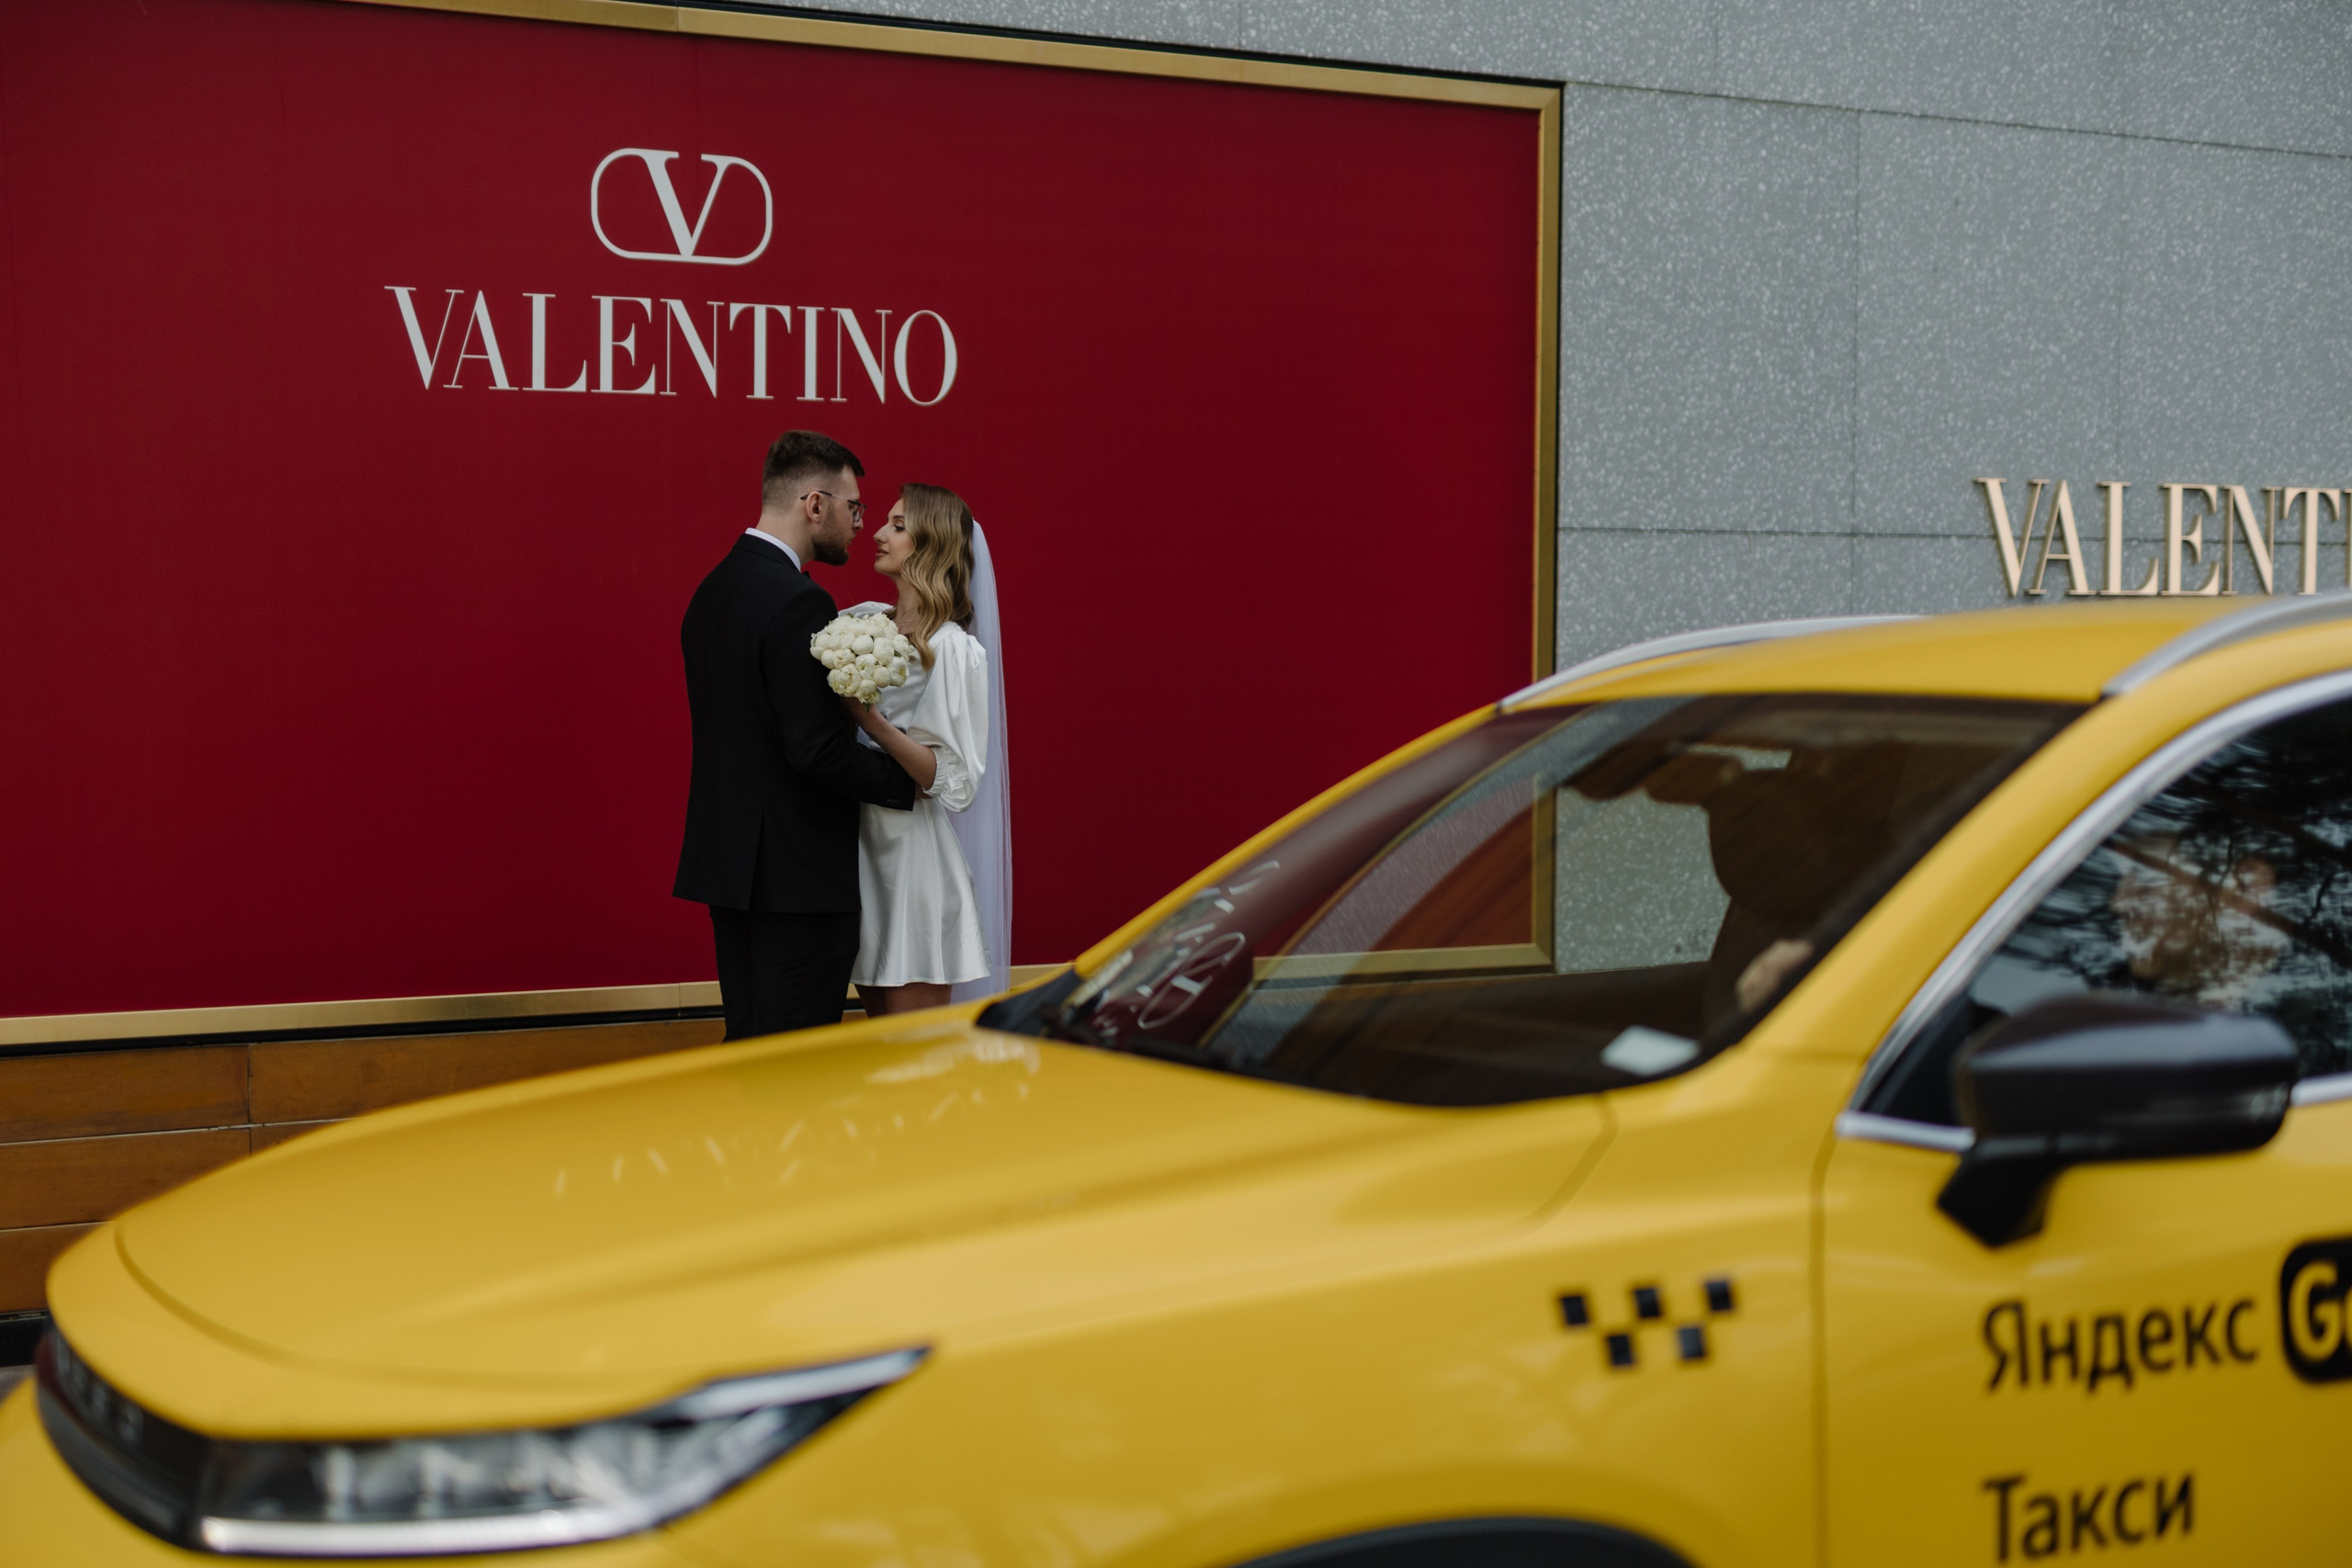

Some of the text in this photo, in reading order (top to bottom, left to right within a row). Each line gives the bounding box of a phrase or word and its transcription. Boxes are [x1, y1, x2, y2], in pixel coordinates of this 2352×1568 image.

[384, 285, 957, 406] VALENTINO
[1983, 1261, 2352, 1395] Яндекс G
[1983, 1472, 2195, 1564] Такси
